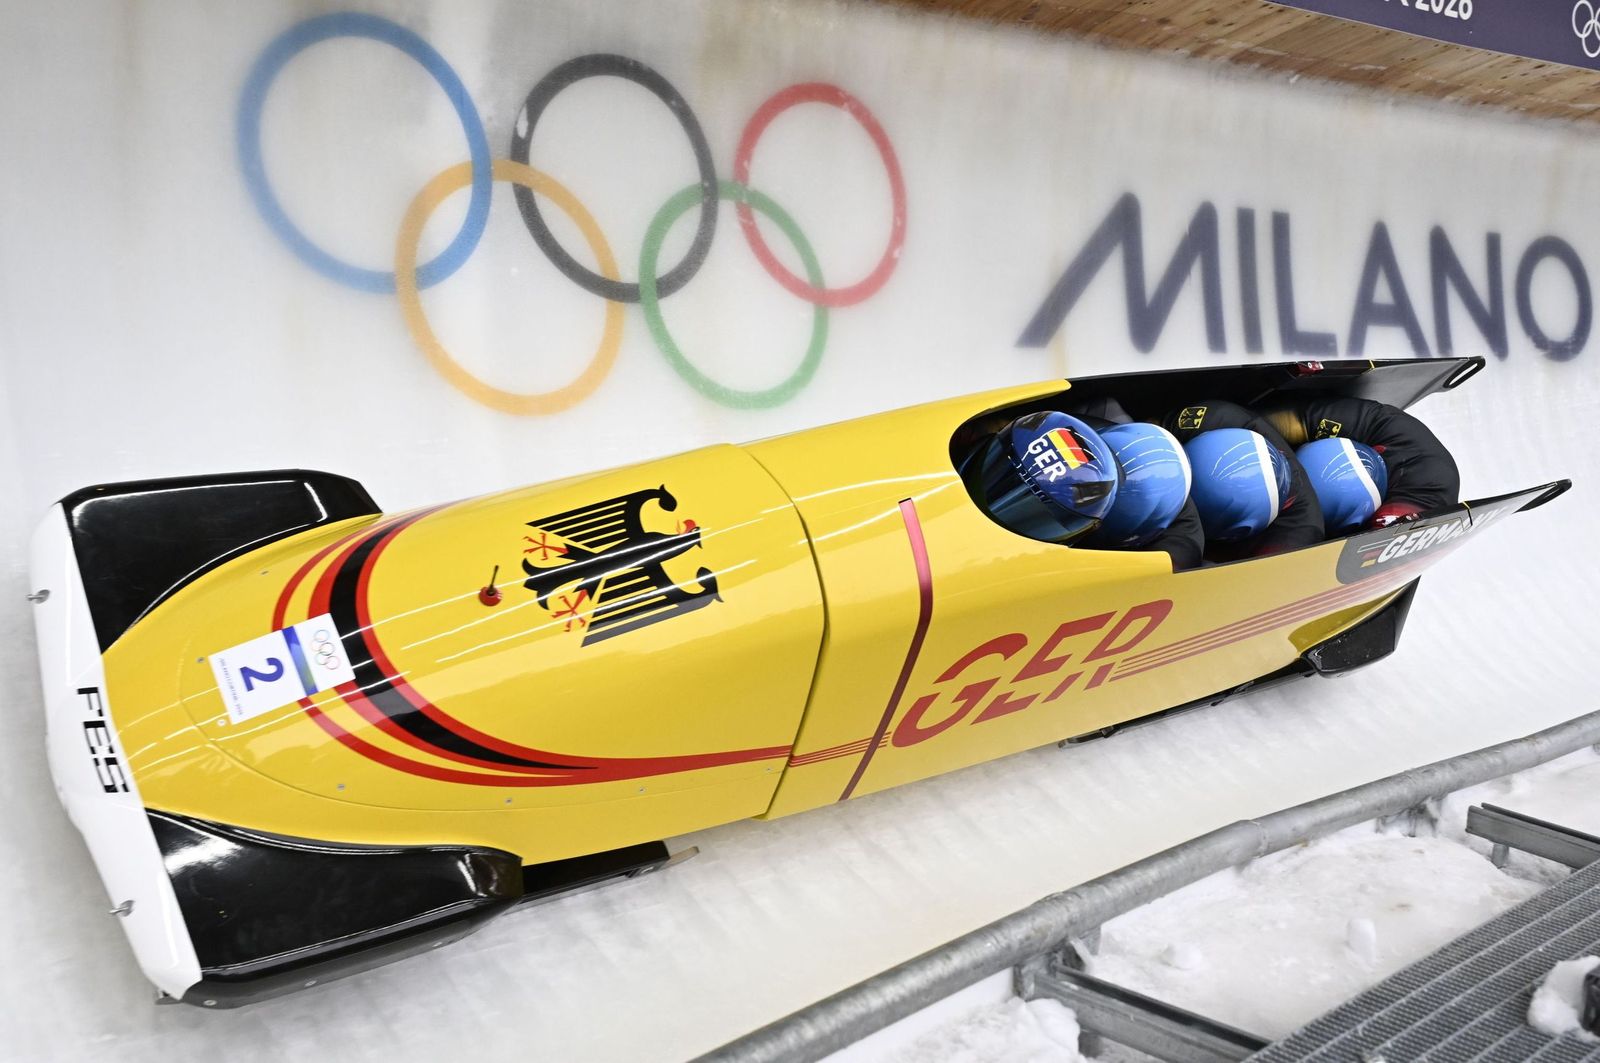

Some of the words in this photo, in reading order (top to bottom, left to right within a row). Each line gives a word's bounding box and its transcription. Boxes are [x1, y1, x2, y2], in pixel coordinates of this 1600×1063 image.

[1014, 191, 1592, 361] MILANO
[1028, 438, 1067, 482] GER
[240, 657, 285, 692] 2
[891, 599, 1174, 748] GER
[77, 687, 130, 793] FES
